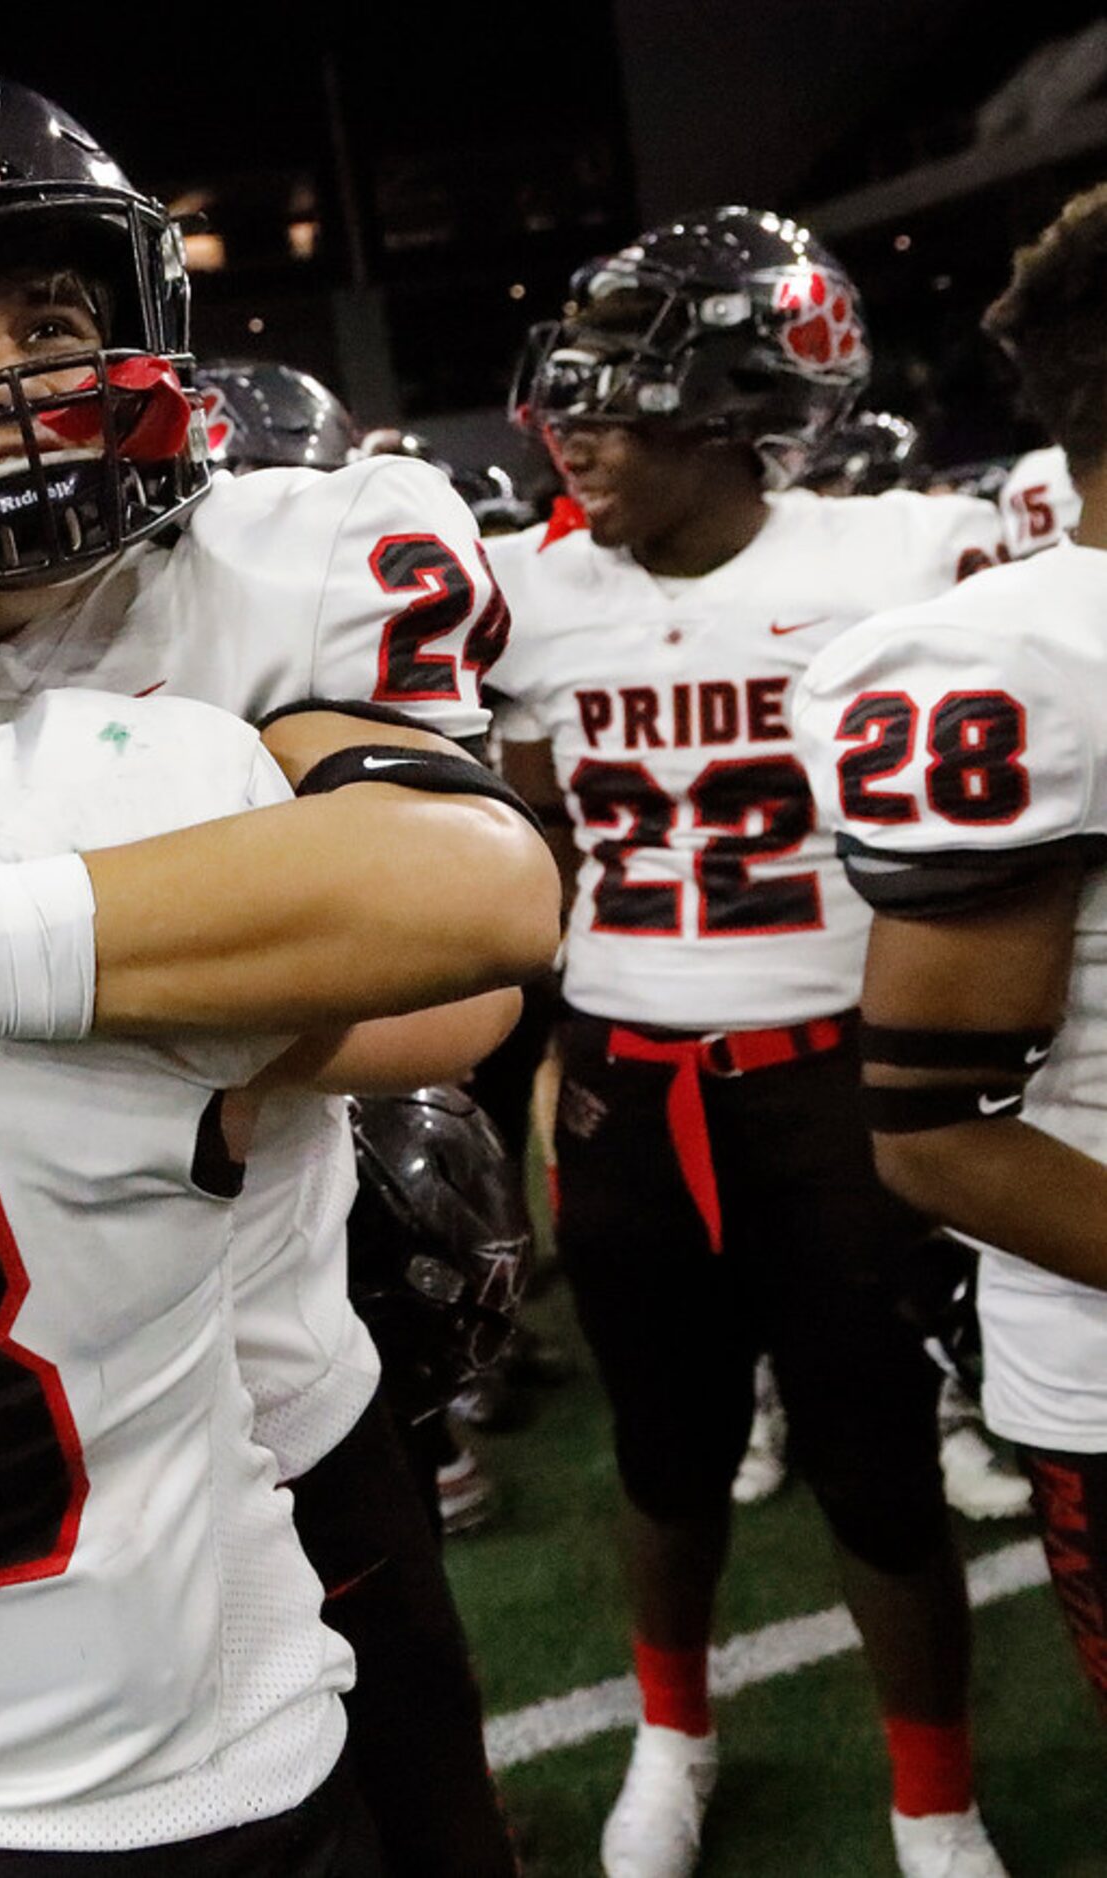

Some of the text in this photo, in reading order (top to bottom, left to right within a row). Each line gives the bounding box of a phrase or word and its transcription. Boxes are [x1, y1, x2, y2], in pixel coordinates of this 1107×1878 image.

[574, 677, 792, 749] PRIDE
[834, 690, 1031, 827] 28
[570, 753, 825, 938] 22
